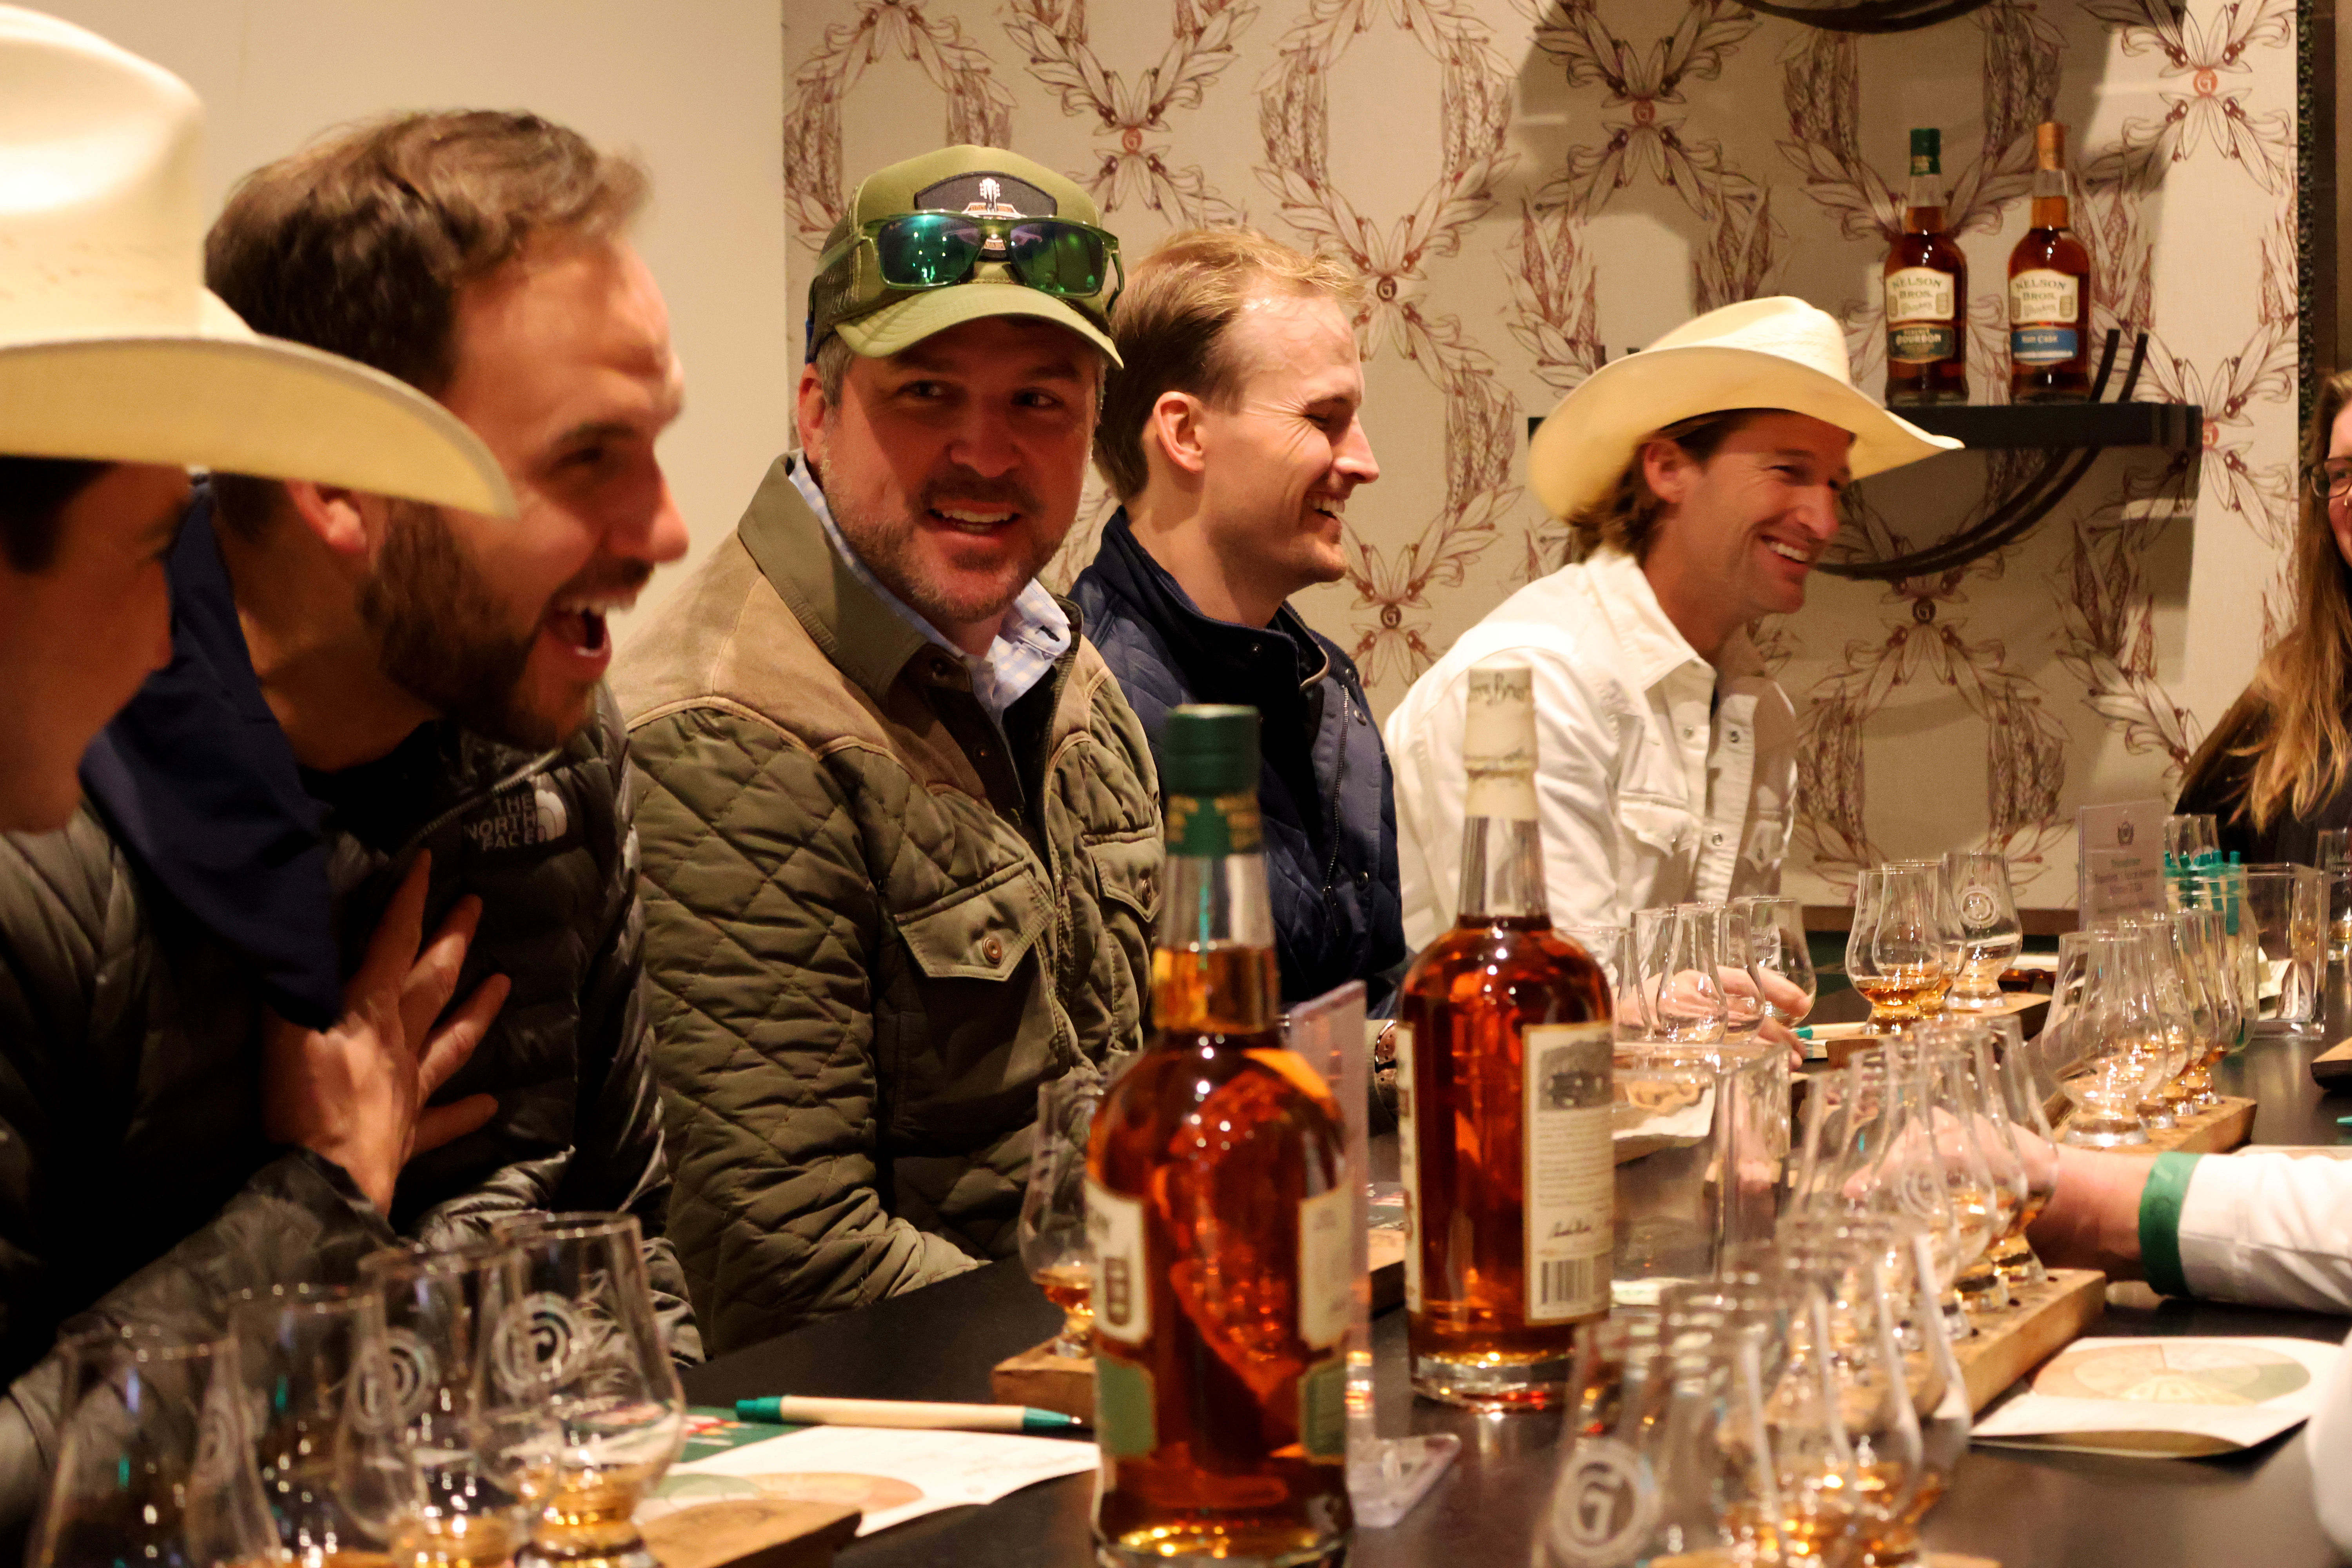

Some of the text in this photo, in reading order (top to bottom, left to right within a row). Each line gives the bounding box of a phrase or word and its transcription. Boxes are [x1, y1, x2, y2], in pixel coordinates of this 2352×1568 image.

[1892, 276, 1942, 289] NELSON
[2016, 279, 2067, 290] NELSON
[493, 793, 535, 815] THE
[463, 811, 537, 840] NORTH
[482, 828, 535, 852] FACE
